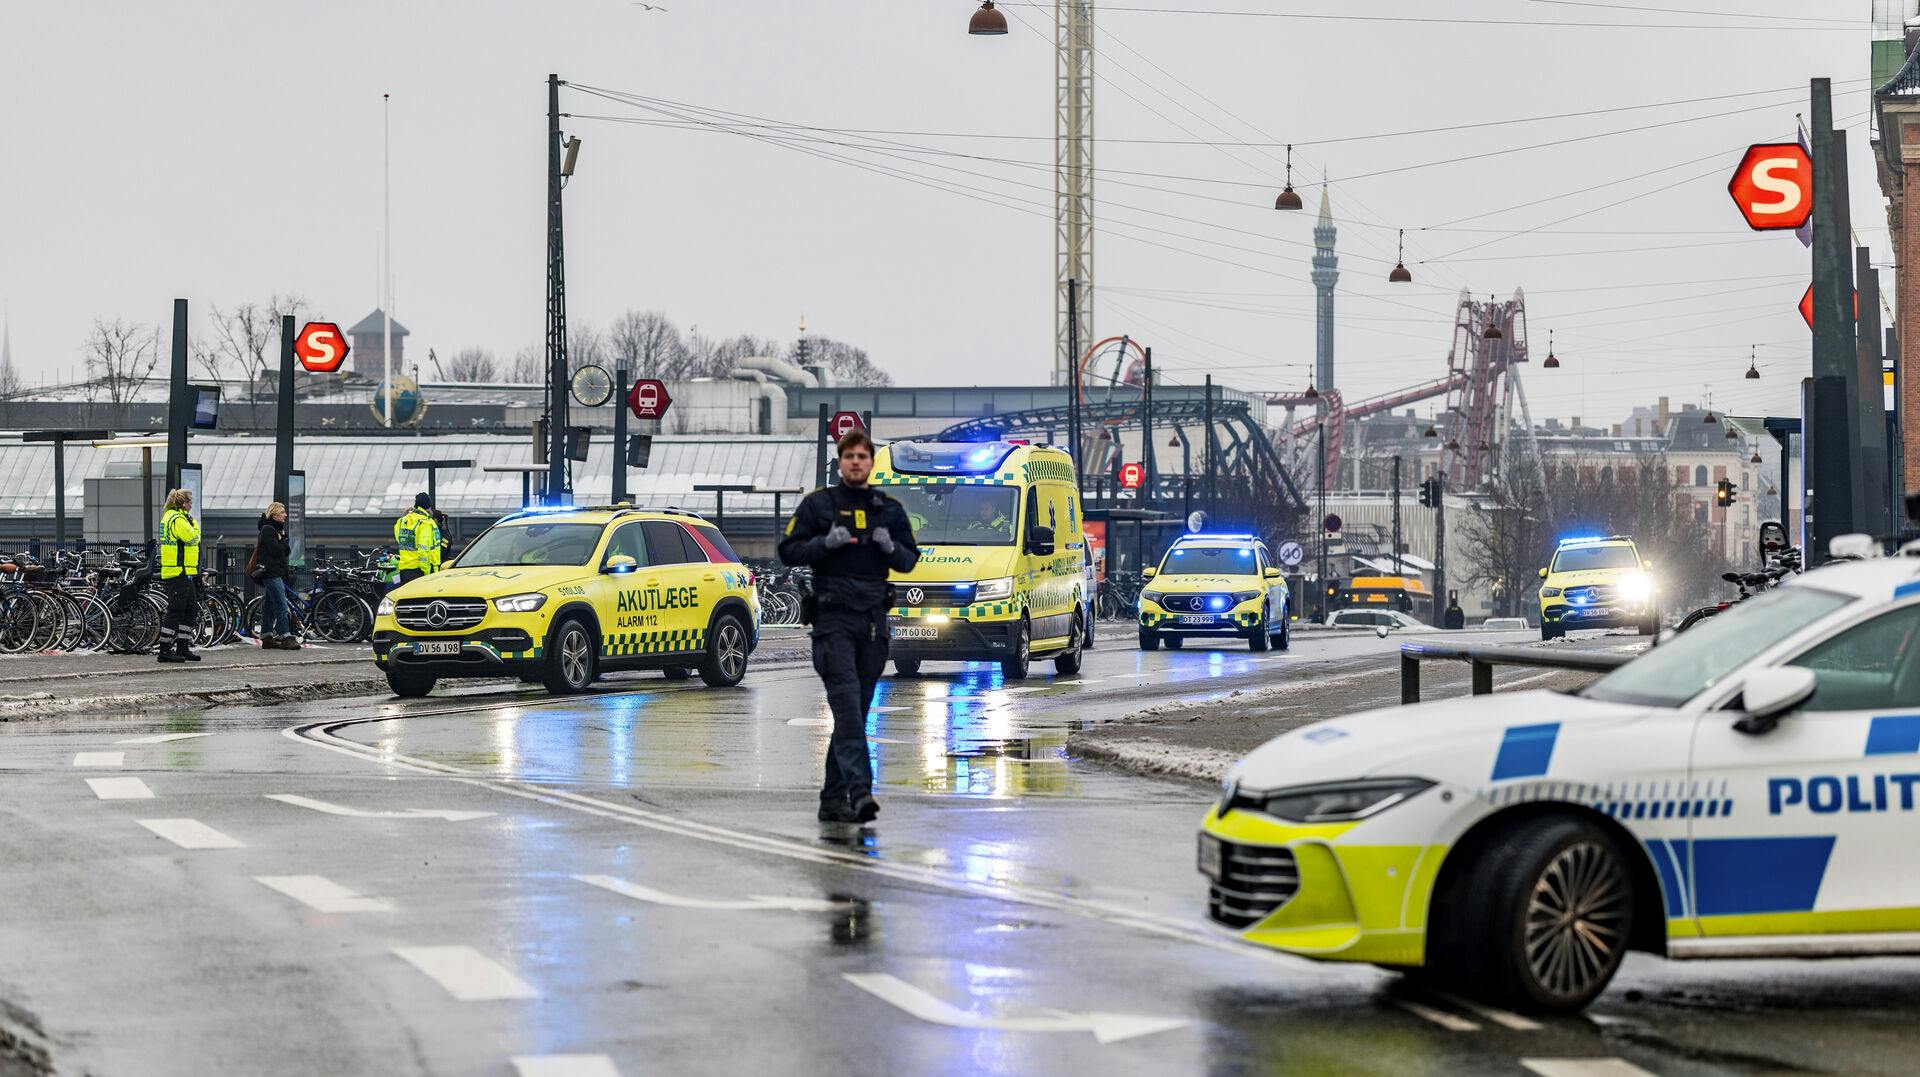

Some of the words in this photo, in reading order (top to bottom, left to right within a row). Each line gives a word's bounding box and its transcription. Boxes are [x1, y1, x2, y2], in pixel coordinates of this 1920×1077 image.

[1751, 157, 1802, 215] S
[307, 331, 335, 364] S
[1282, 547, 1301, 561] 40
[617, 586, 699, 612] AKUTLÆGE
[617, 616, 644, 628] ALARM
[646, 615, 658, 626] 112
[896, 628, 908, 637] DM
[909, 628, 919, 637] 60
[921, 628, 937, 637] 062
[419, 644, 430, 653] DV
[431, 644, 442, 653] 56
[443, 643, 459, 653] 198
[1768, 774, 1920, 815] POLIT
